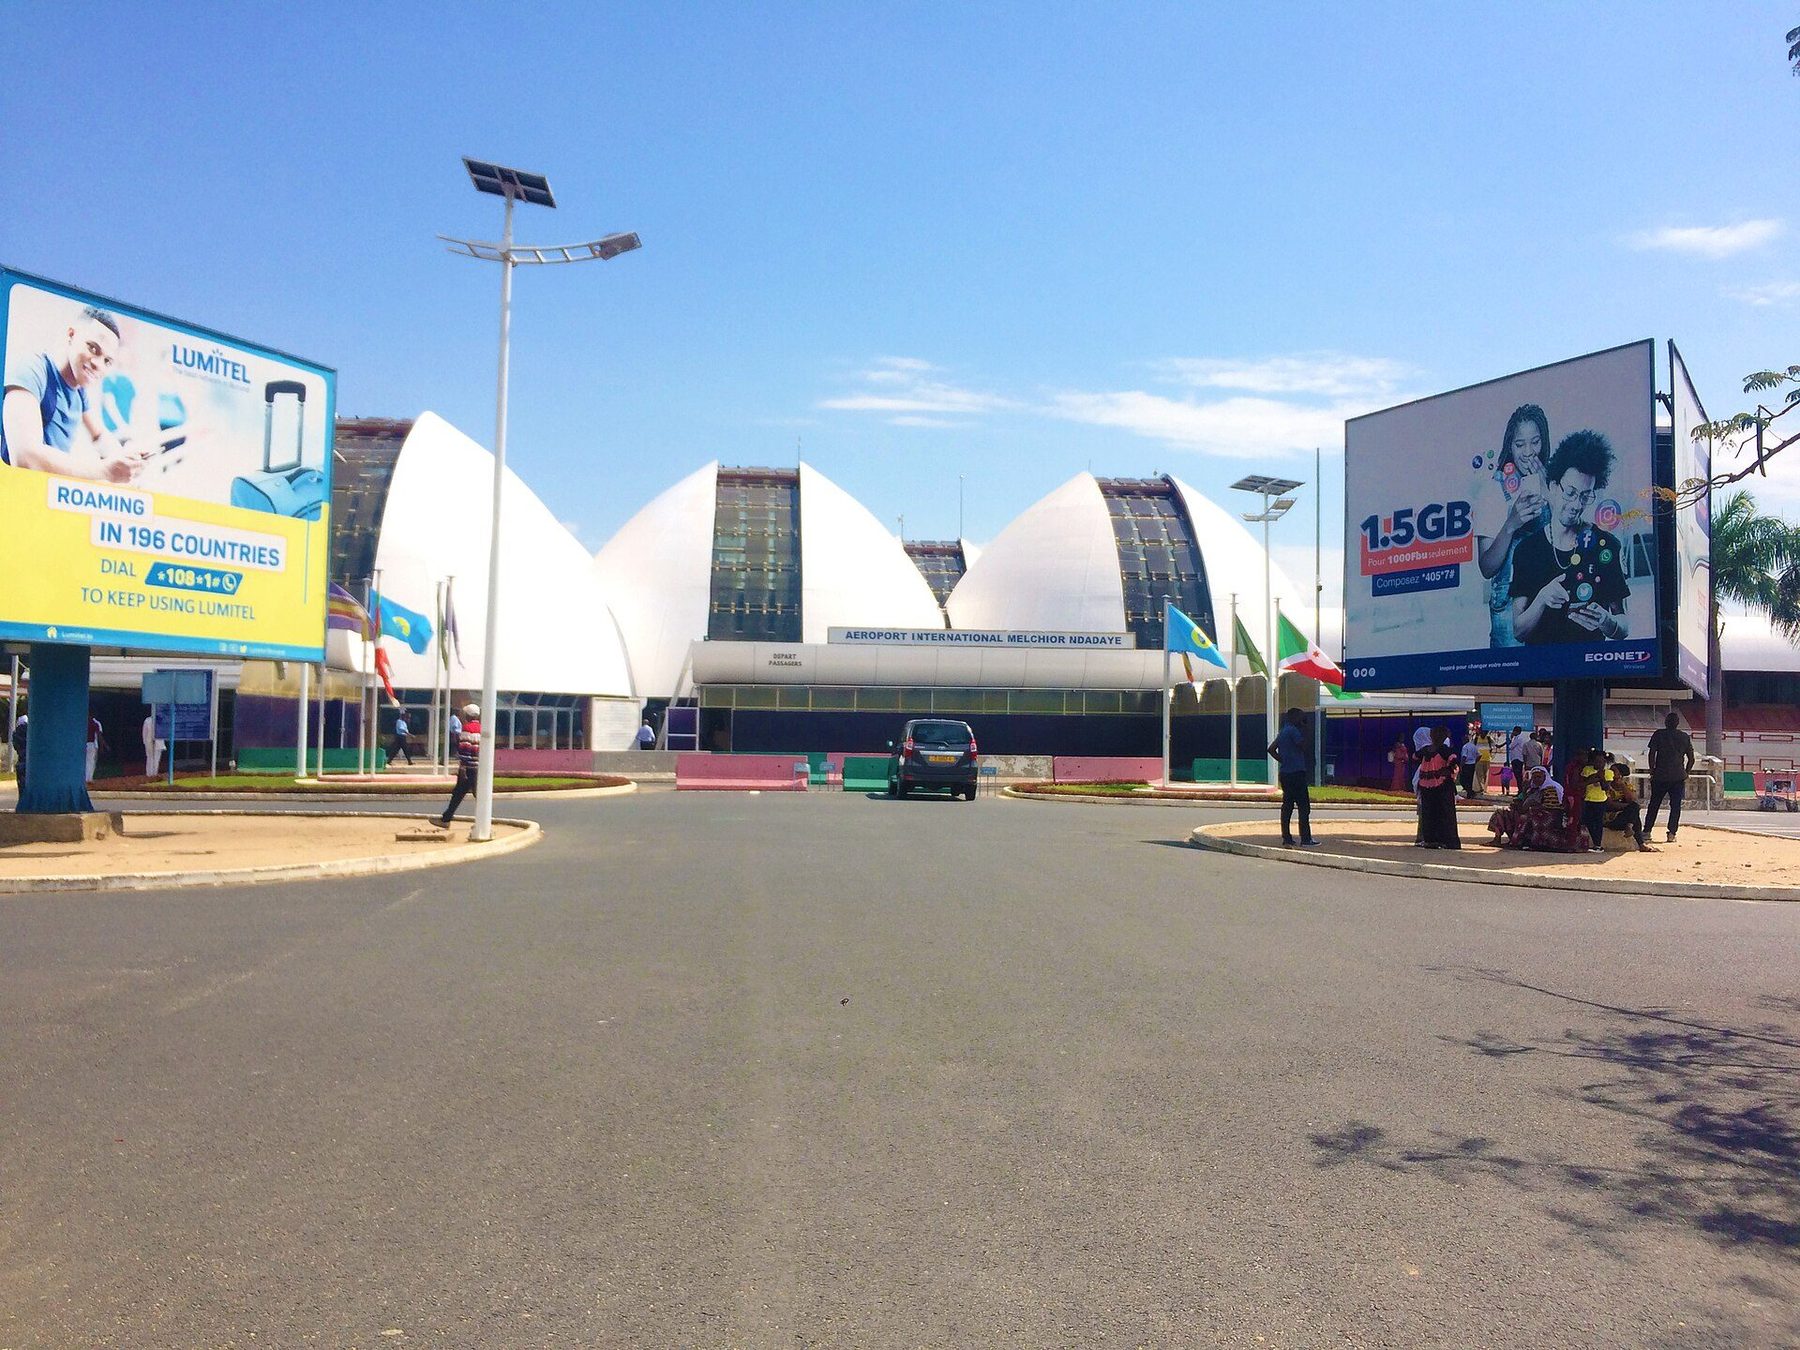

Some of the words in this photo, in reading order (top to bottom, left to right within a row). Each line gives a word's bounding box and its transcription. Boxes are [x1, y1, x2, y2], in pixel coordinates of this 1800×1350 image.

[57, 486, 145, 516] ROAMING
[1360, 501, 1472, 550] 1.5GB
[100, 521, 122, 543] IN
[128, 526, 166, 550] 196
[171, 533, 280, 567] COUNTRIES
[101, 558, 137, 577] DIAL
[1368, 558, 1386, 567] Pour
[1376, 576, 1420, 589] Composez
[81, 586, 103, 604] TO
[107, 590, 146, 608] KEEP
[150, 595, 195, 614] USING
[199, 600, 256, 620] LUMITEL
[845, 631, 907, 641] AEROPORT
[911, 632, 1003, 643] INTERNATIONAL
[1007, 634, 1066, 644] MELCHIOR
[1069, 636, 1122, 645] NDADAYE
[1585, 651, 1646, 662] ECONET
